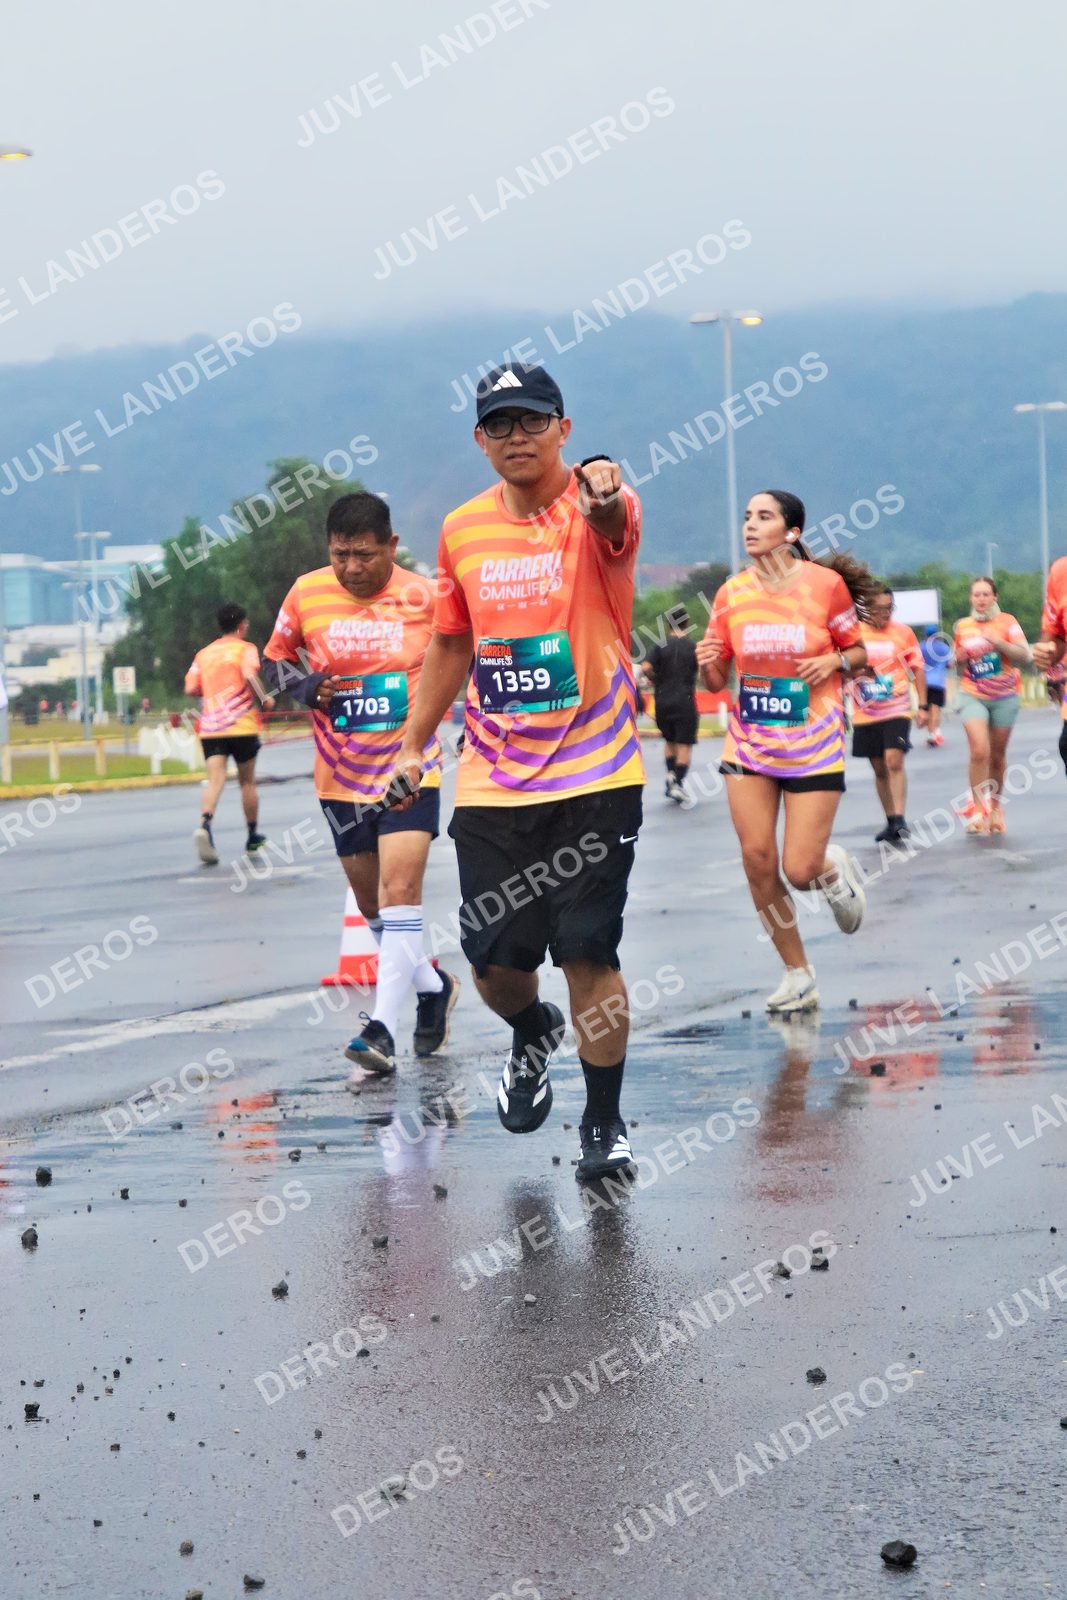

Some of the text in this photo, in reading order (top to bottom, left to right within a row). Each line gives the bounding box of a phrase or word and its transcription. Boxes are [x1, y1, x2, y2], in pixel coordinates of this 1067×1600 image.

[480, 550, 562, 583] CARRERA
[479, 580, 546, 601] OMNILIFE
[328, 619, 404, 639] CARRERA
[743, 624, 806, 641] CARRERA
[480, 645, 513, 657] CARRERA
[539, 638, 560, 656] 10K
[384, 676, 400, 689] 10K
[492, 668, 550, 693] 1359
[789, 681, 804, 692] 10K
[342, 697, 390, 716] 1703
[750, 695, 792, 714] 1190
